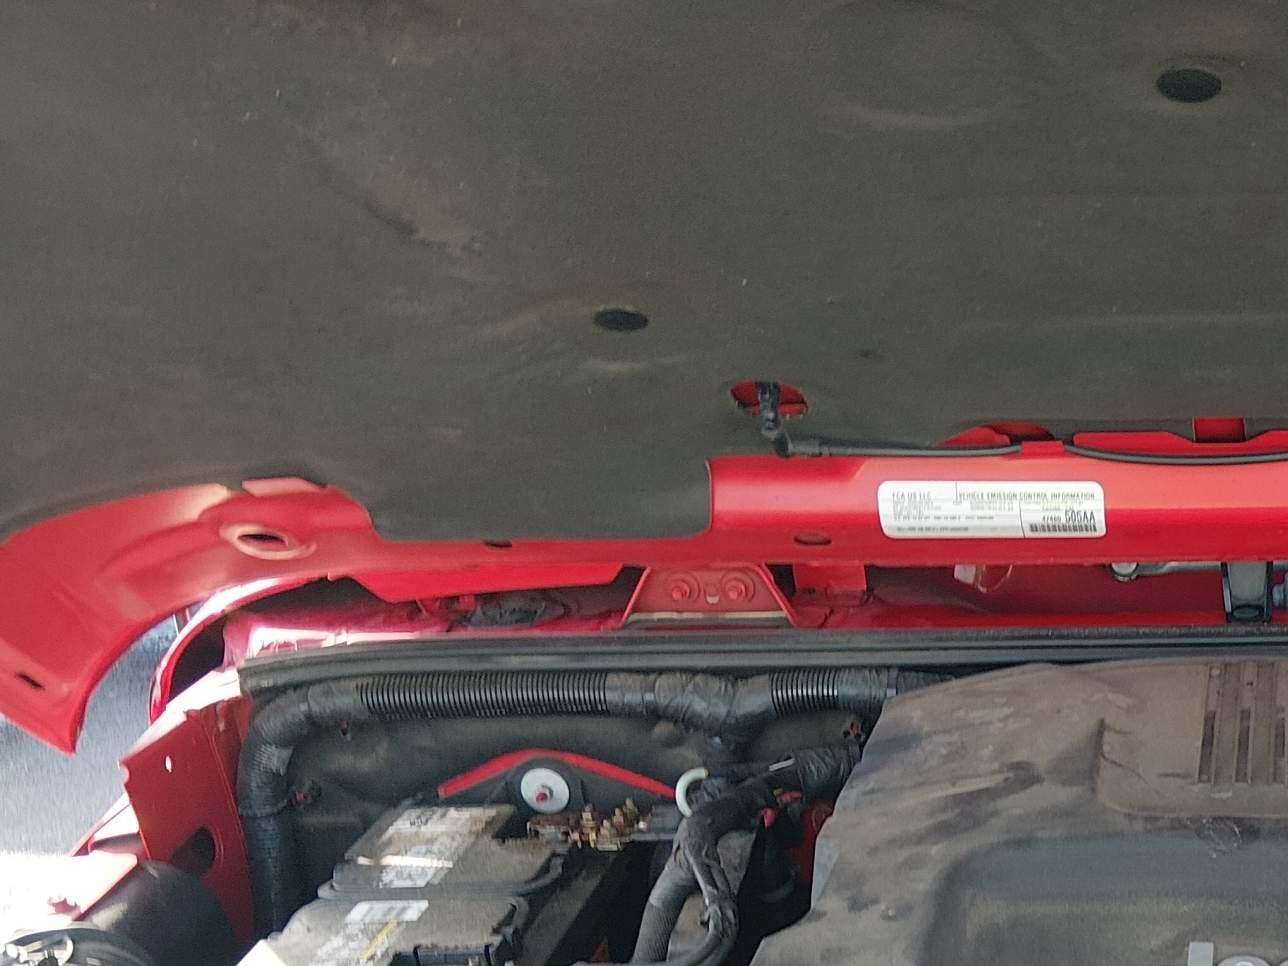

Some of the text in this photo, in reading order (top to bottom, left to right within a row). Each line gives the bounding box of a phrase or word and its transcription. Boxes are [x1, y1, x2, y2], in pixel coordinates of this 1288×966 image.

[959, 491, 1095, 500] VEHICLE EMISSION CONTROL INFORMATION
